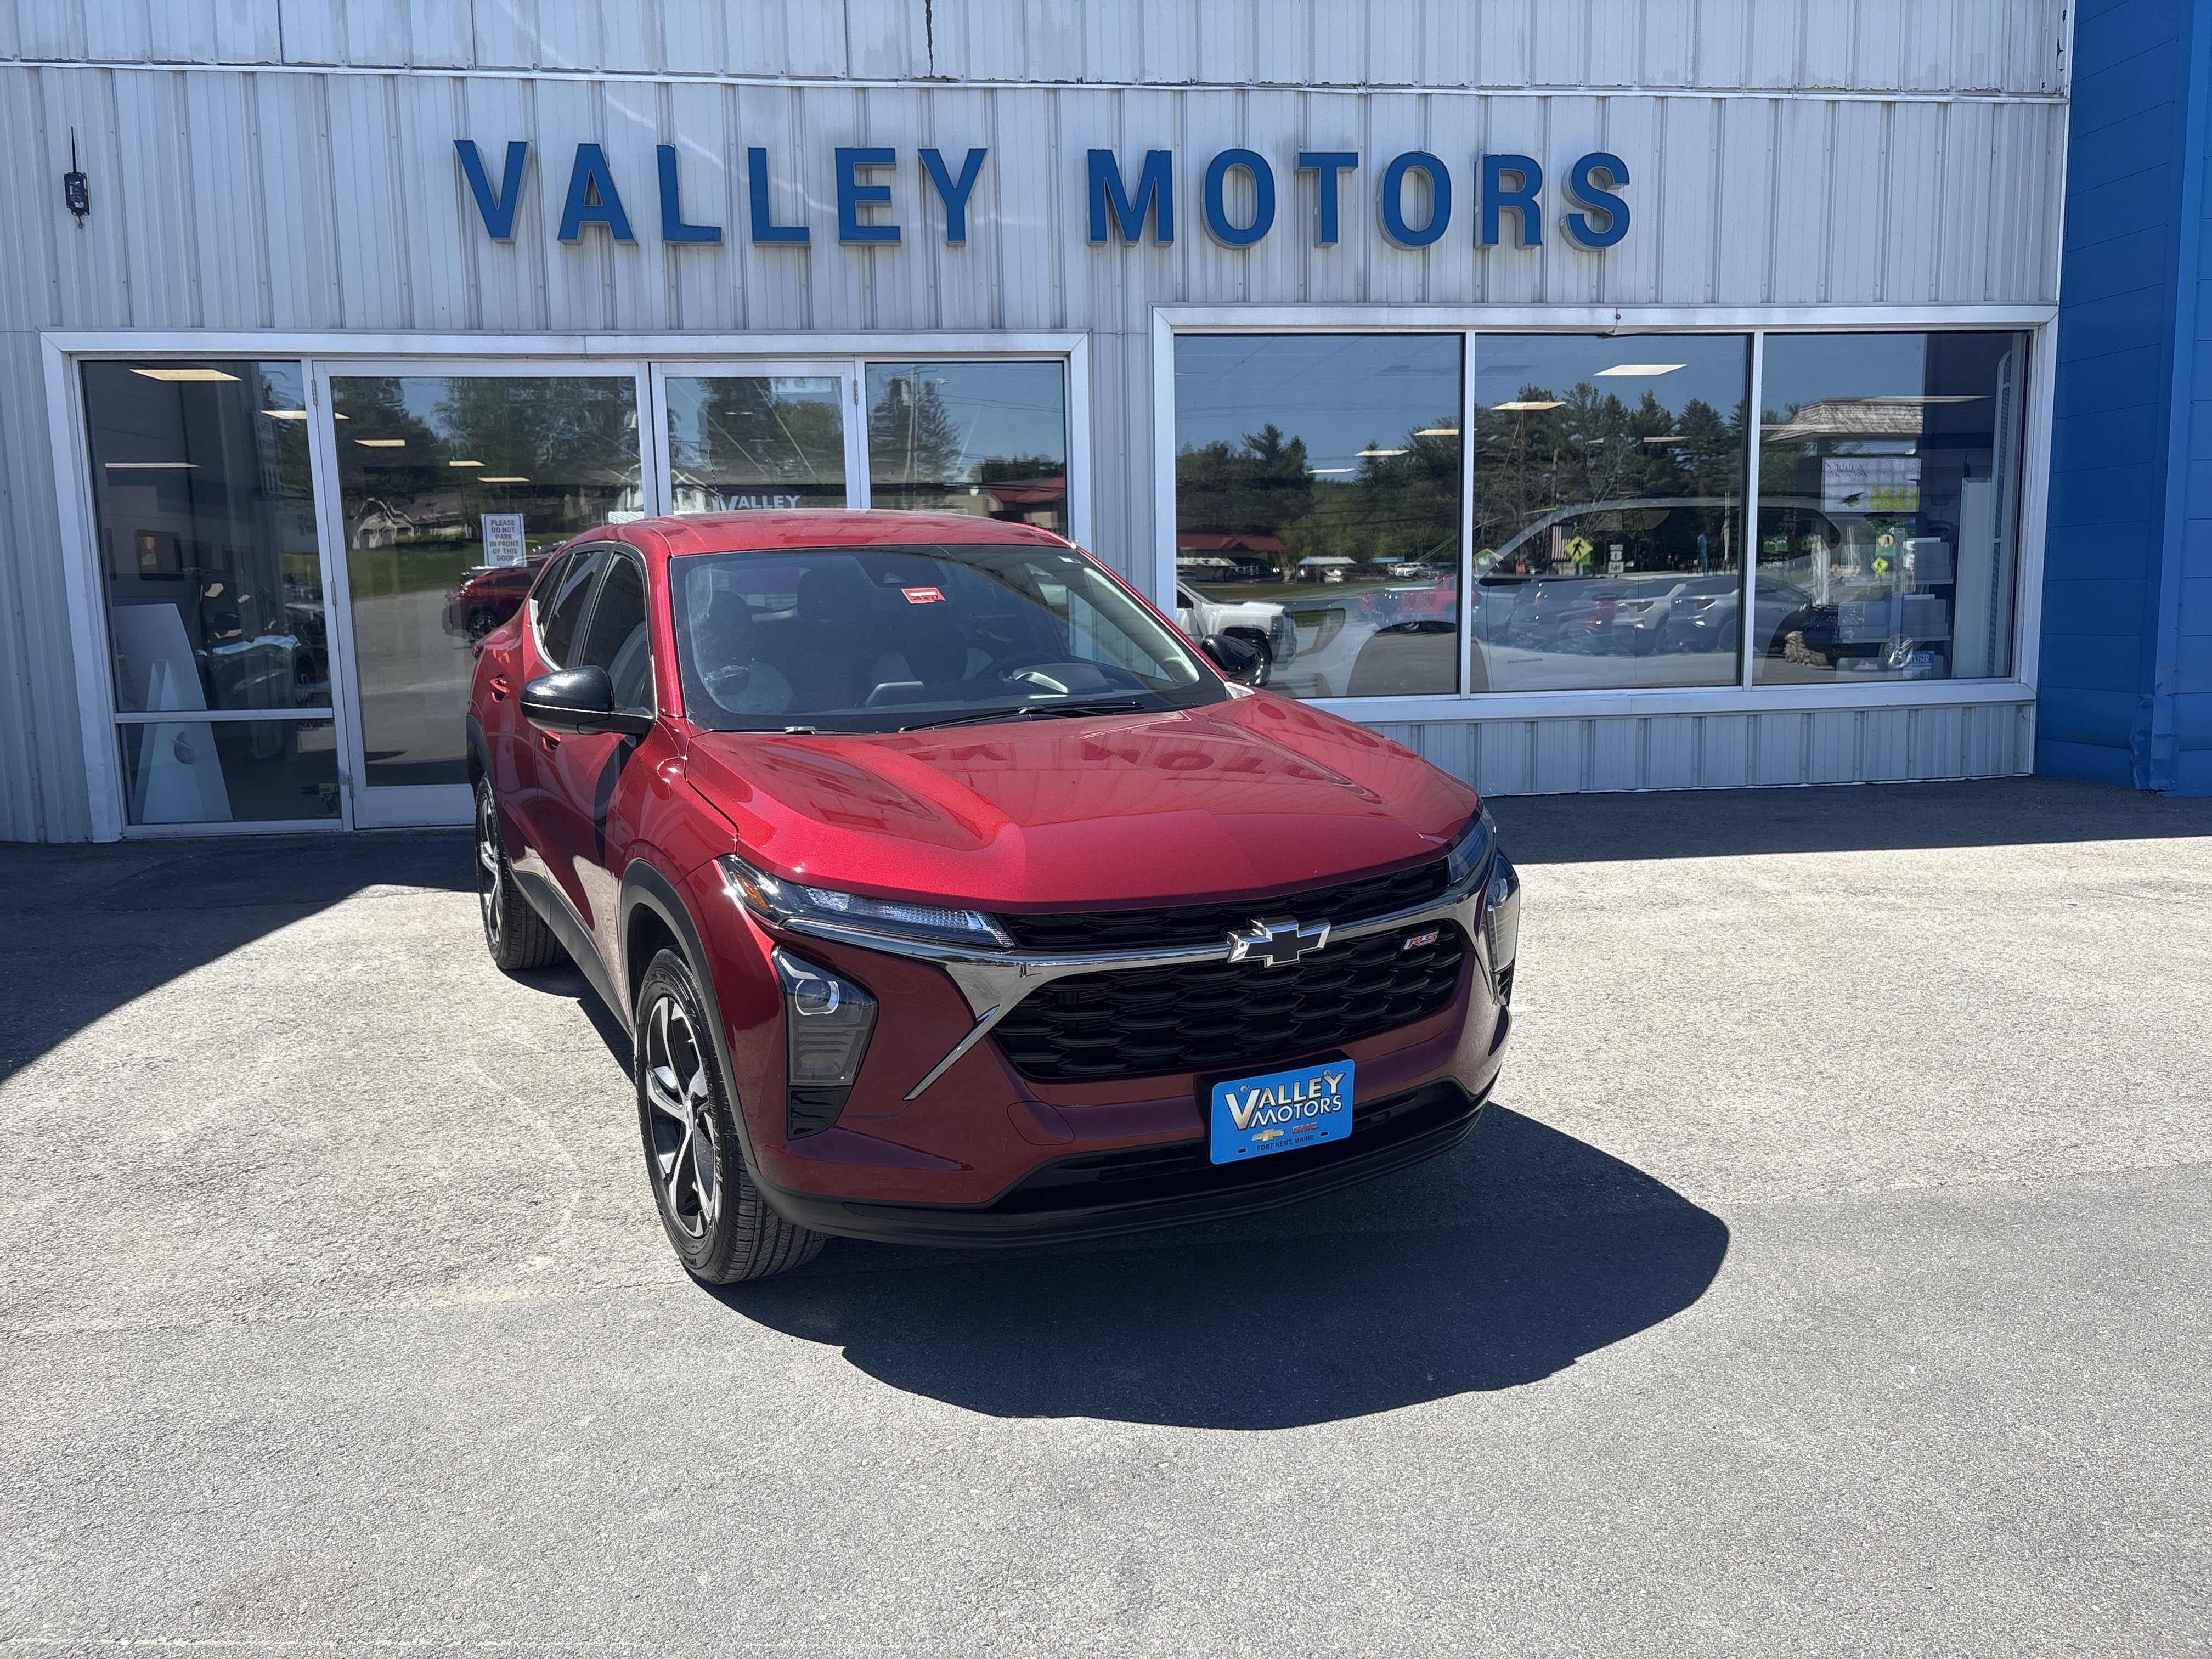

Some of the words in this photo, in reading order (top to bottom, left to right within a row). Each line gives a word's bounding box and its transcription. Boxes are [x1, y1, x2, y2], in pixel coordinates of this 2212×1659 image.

[454, 139, 988, 246] VALLEY
[1086, 148, 1631, 251] MOTORS
[719, 494, 802, 511] VALLEY
[1403, 930, 1439, 950] RS
[1223, 1072, 1346, 1131] VALLEY
[1249, 1093, 1342, 1128] MOTORS
[1291, 1121, 1319, 1134] GMC
[1256, 1143, 1274, 1152] FORT
[1275, 1138, 1293, 1148] KENT,
[1295, 1135, 1314, 1144] MAINE
